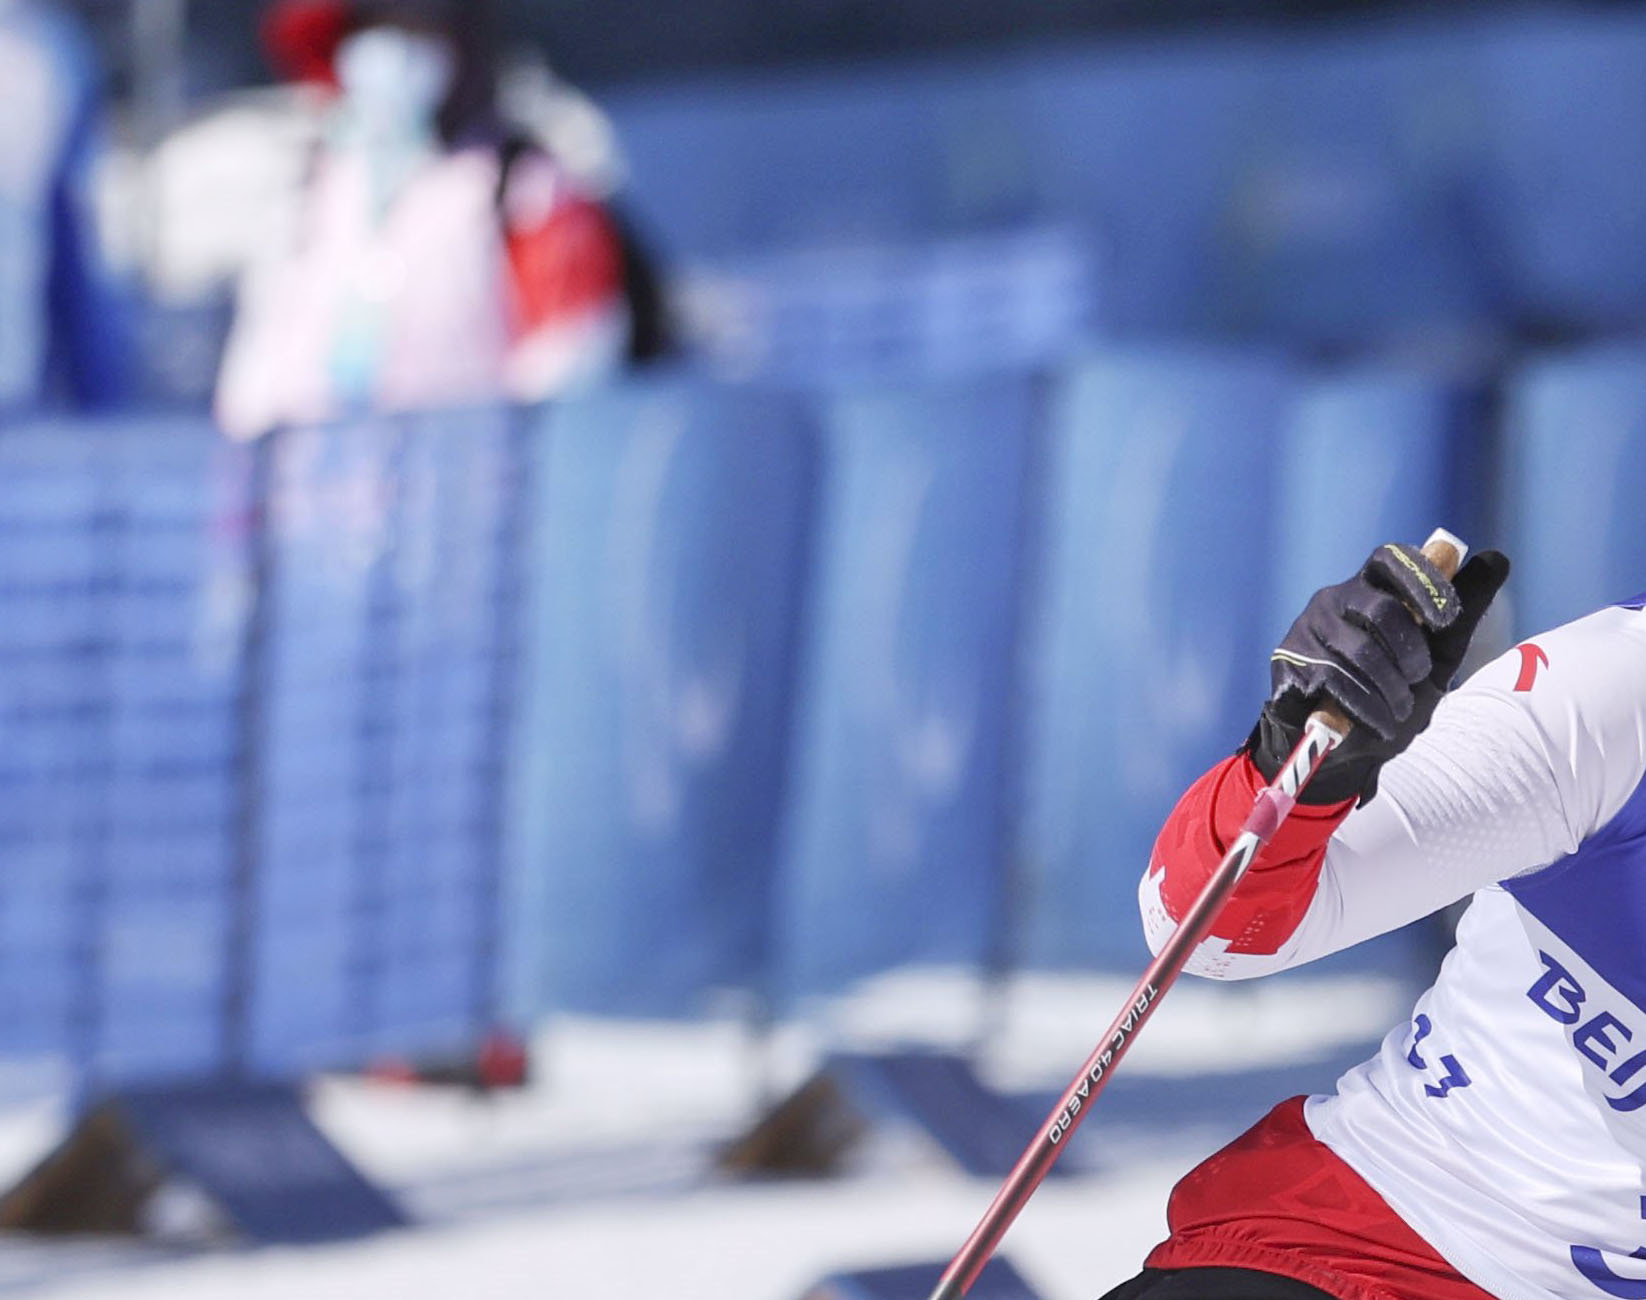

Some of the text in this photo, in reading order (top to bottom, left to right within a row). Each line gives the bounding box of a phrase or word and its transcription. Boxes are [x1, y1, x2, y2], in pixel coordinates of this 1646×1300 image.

[1049, 983, 1159, 1145] TRIAC 4.0 AERO
